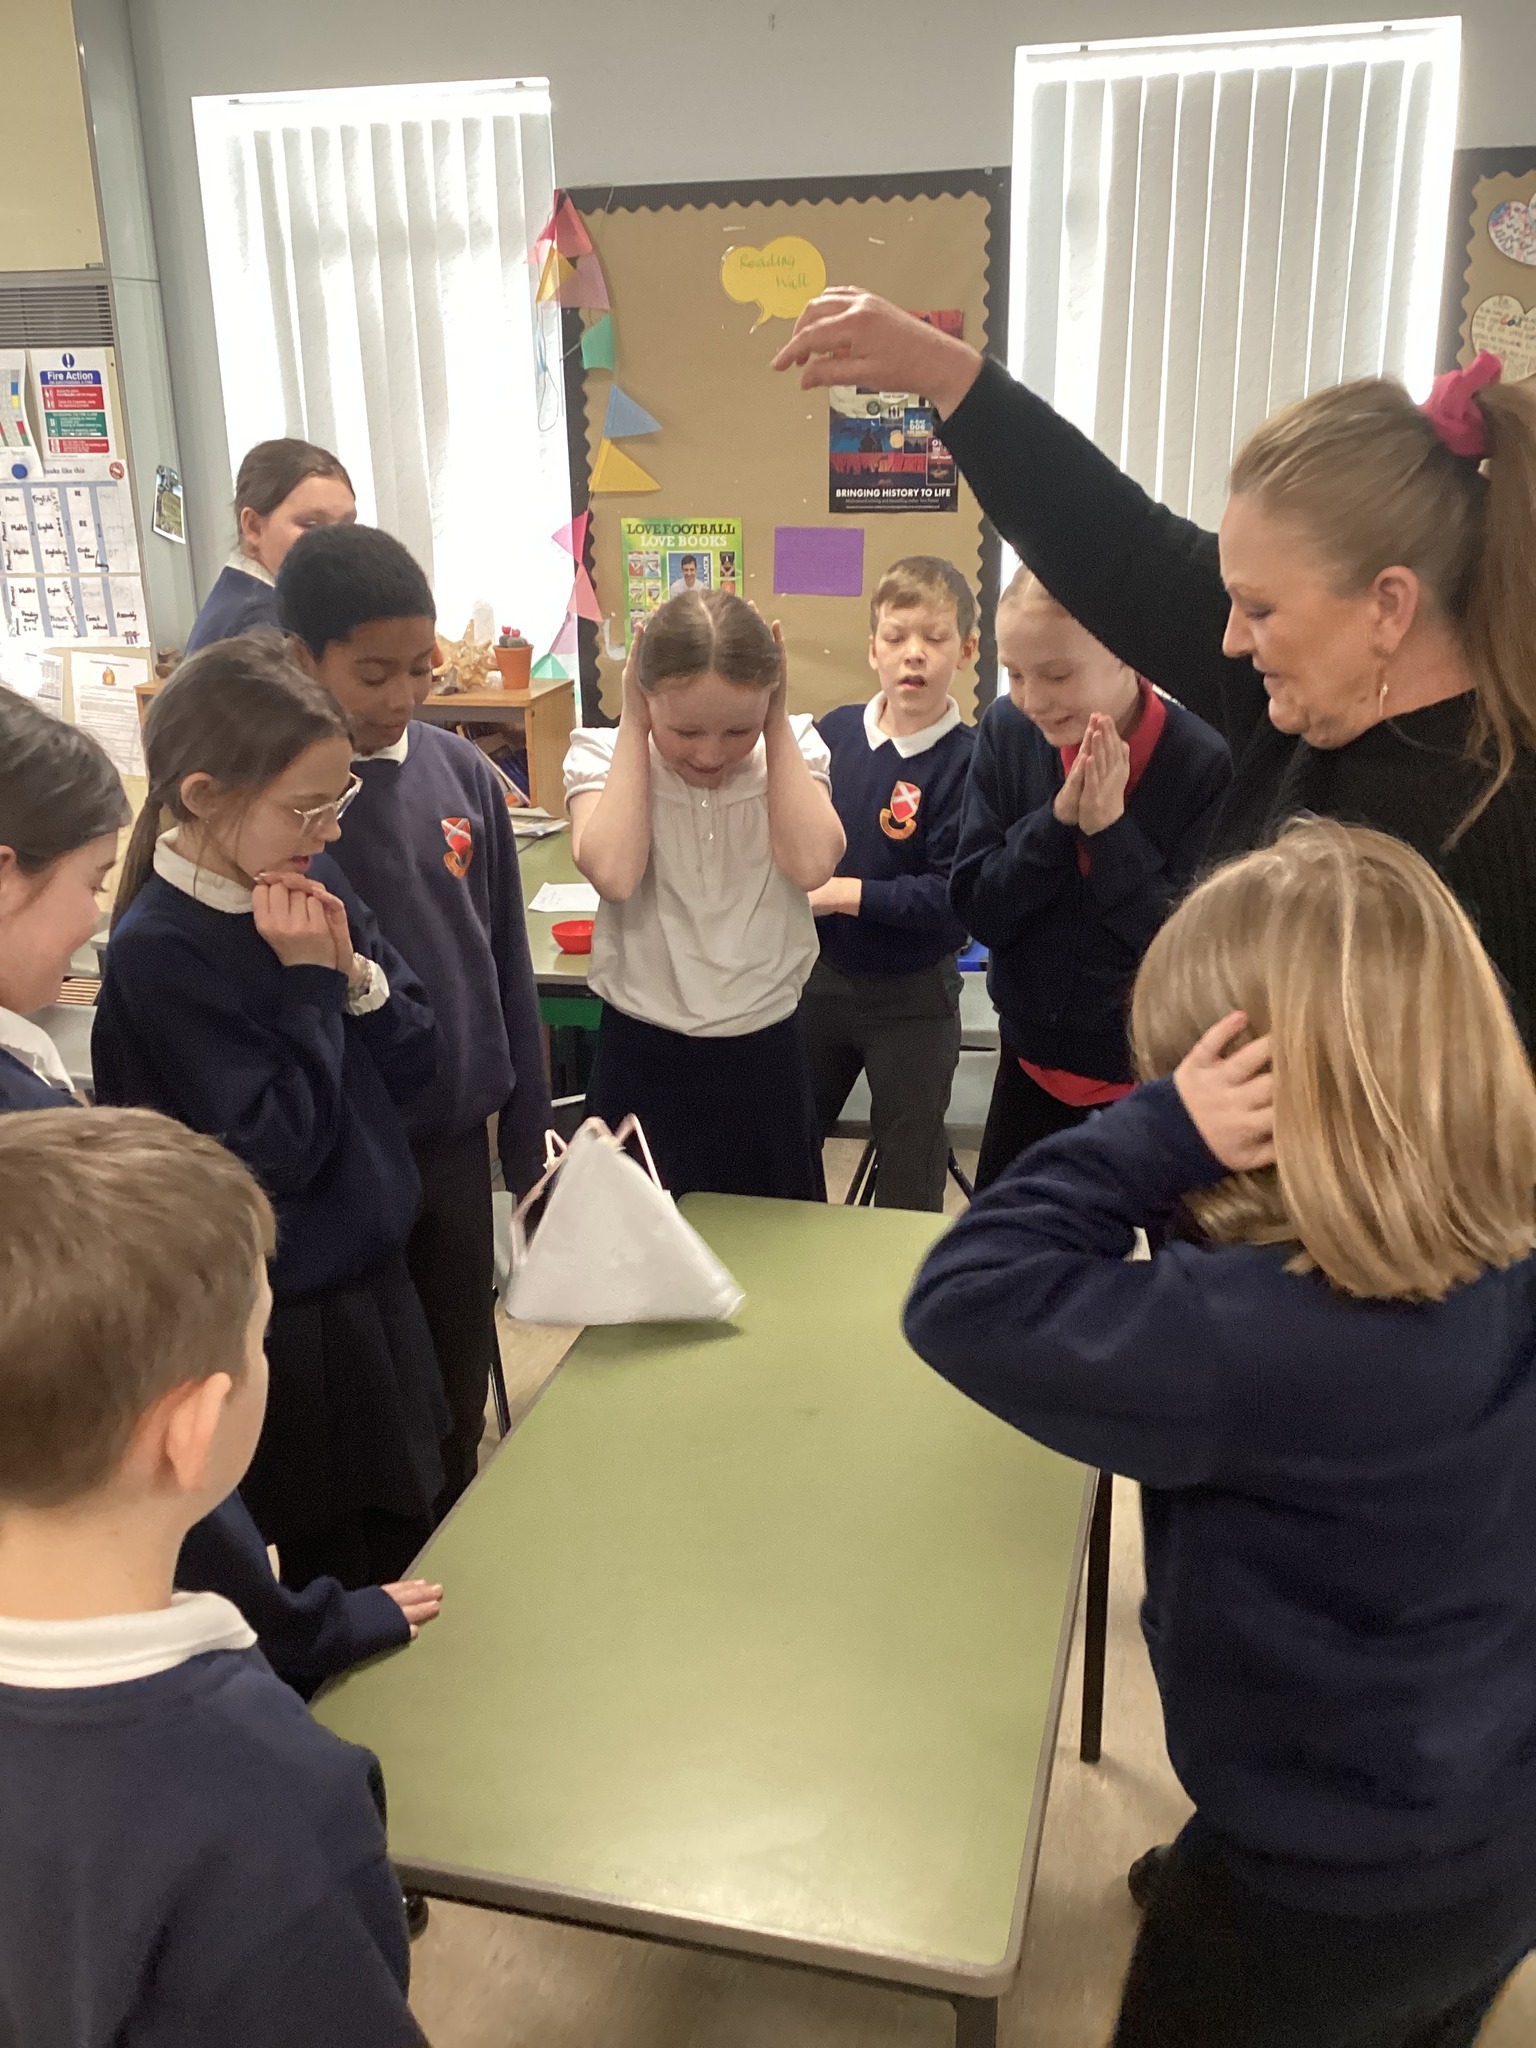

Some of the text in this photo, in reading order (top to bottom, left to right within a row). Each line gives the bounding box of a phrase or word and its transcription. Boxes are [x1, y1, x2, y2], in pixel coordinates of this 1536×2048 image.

[47, 371, 93, 380] Fire Action
[836, 488, 951, 498] BRINGING HISTORY TO LIFE
[627, 523, 735, 535] LOVE FOOTBALL
[640, 535, 728, 547] LOVE BOOKS
